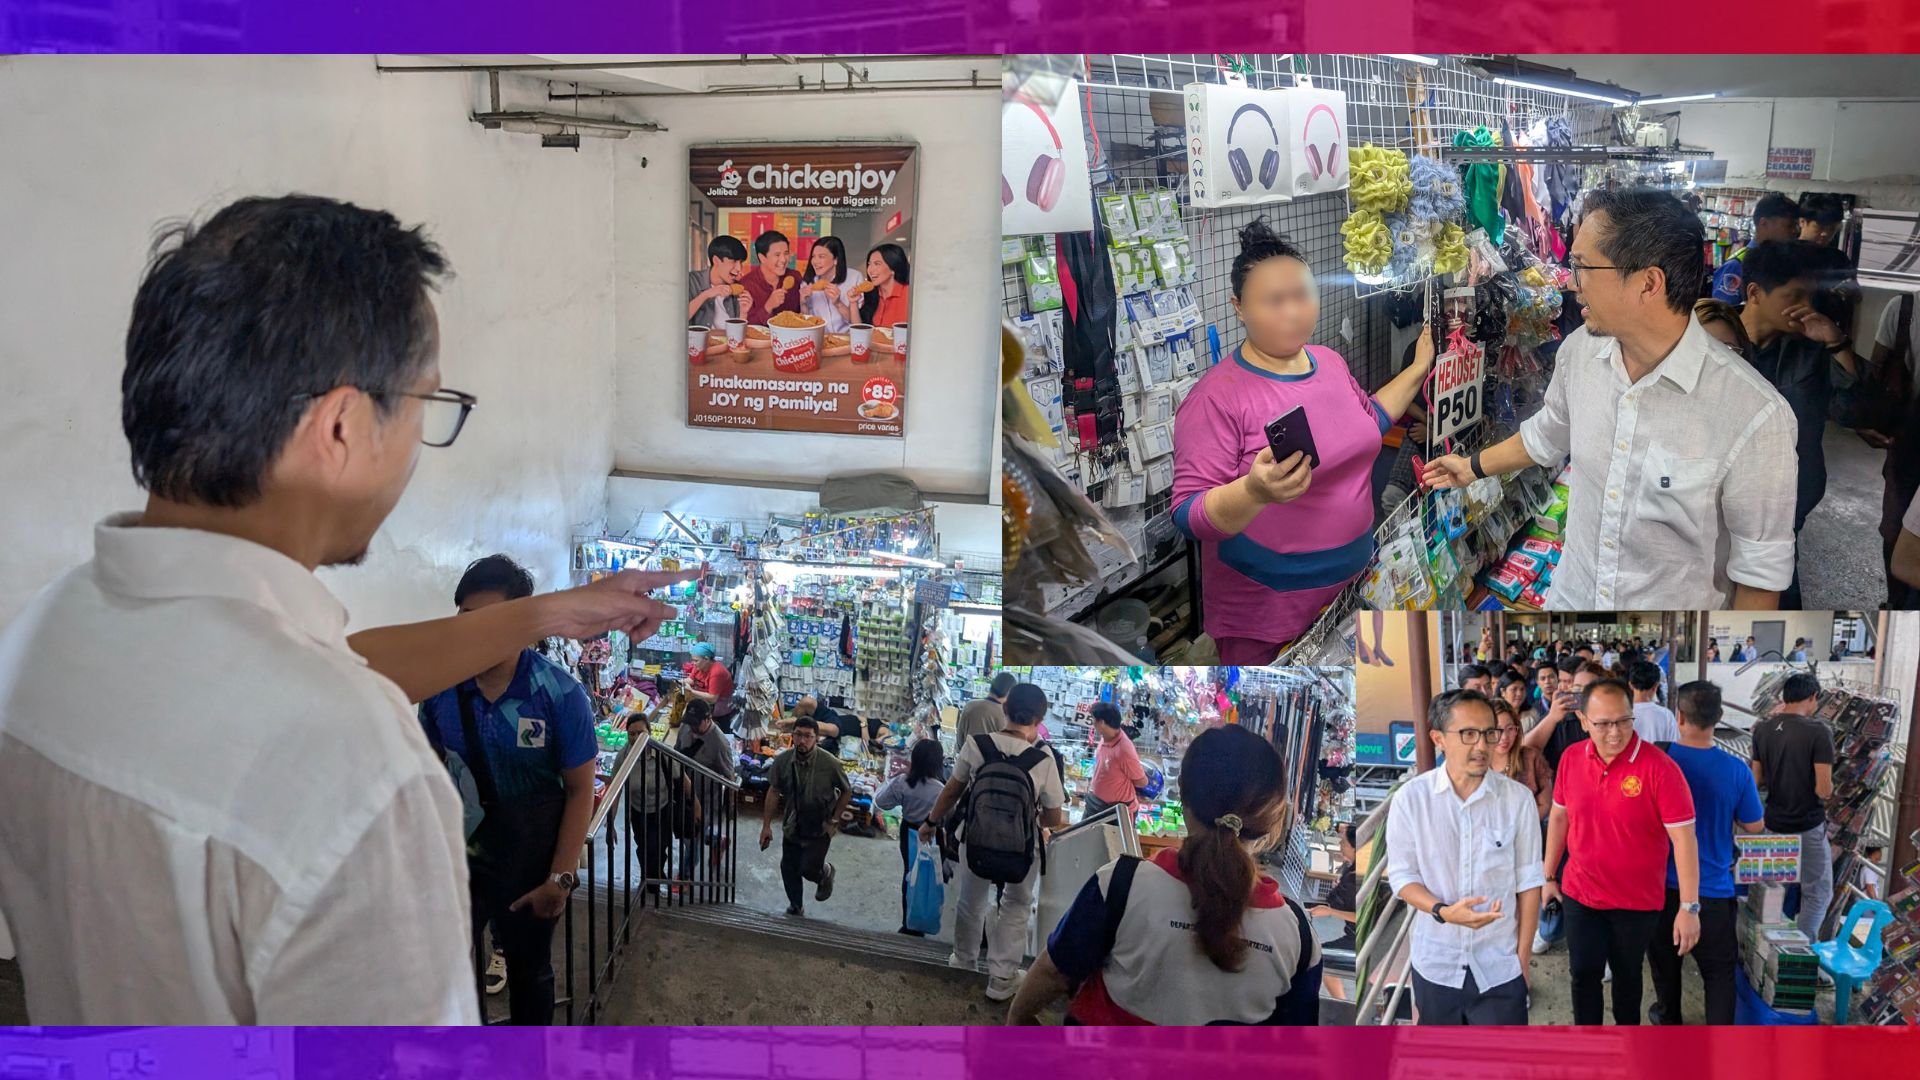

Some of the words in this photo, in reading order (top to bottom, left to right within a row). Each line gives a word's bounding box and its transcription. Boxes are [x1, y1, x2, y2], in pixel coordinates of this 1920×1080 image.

[1767, 163, 1811, 171] CERAMIC
[748, 163, 896, 195] Chickenjoy
[707, 188, 738, 196] Jollibee
[746, 196, 803, 206] Best-Tasting
[805, 197, 820, 206] na,
[823, 196, 840, 205] Our
[843, 196, 878, 207] Biggest
[881, 196, 896, 206] pa!
[1438, 350, 1482, 395] HEADSET
[699, 375, 823, 394] Pinakamasarap
[828, 382, 849, 393] na
[709, 393, 740, 406] JOY
[744, 397, 764, 411] ng
[768, 396, 838, 415] Pamilya!
[1437, 385, 1477, 436] P50
[858, 423, 876, 431] price
[877, 424, 899, 432] varies
[1077, 703, 1093, 713] HEA
[1075, 712, 1093, 726] P5
[1736, 836, 1799, 858] TEMPERED
[1739, 858, 1797, 882] GLASS
